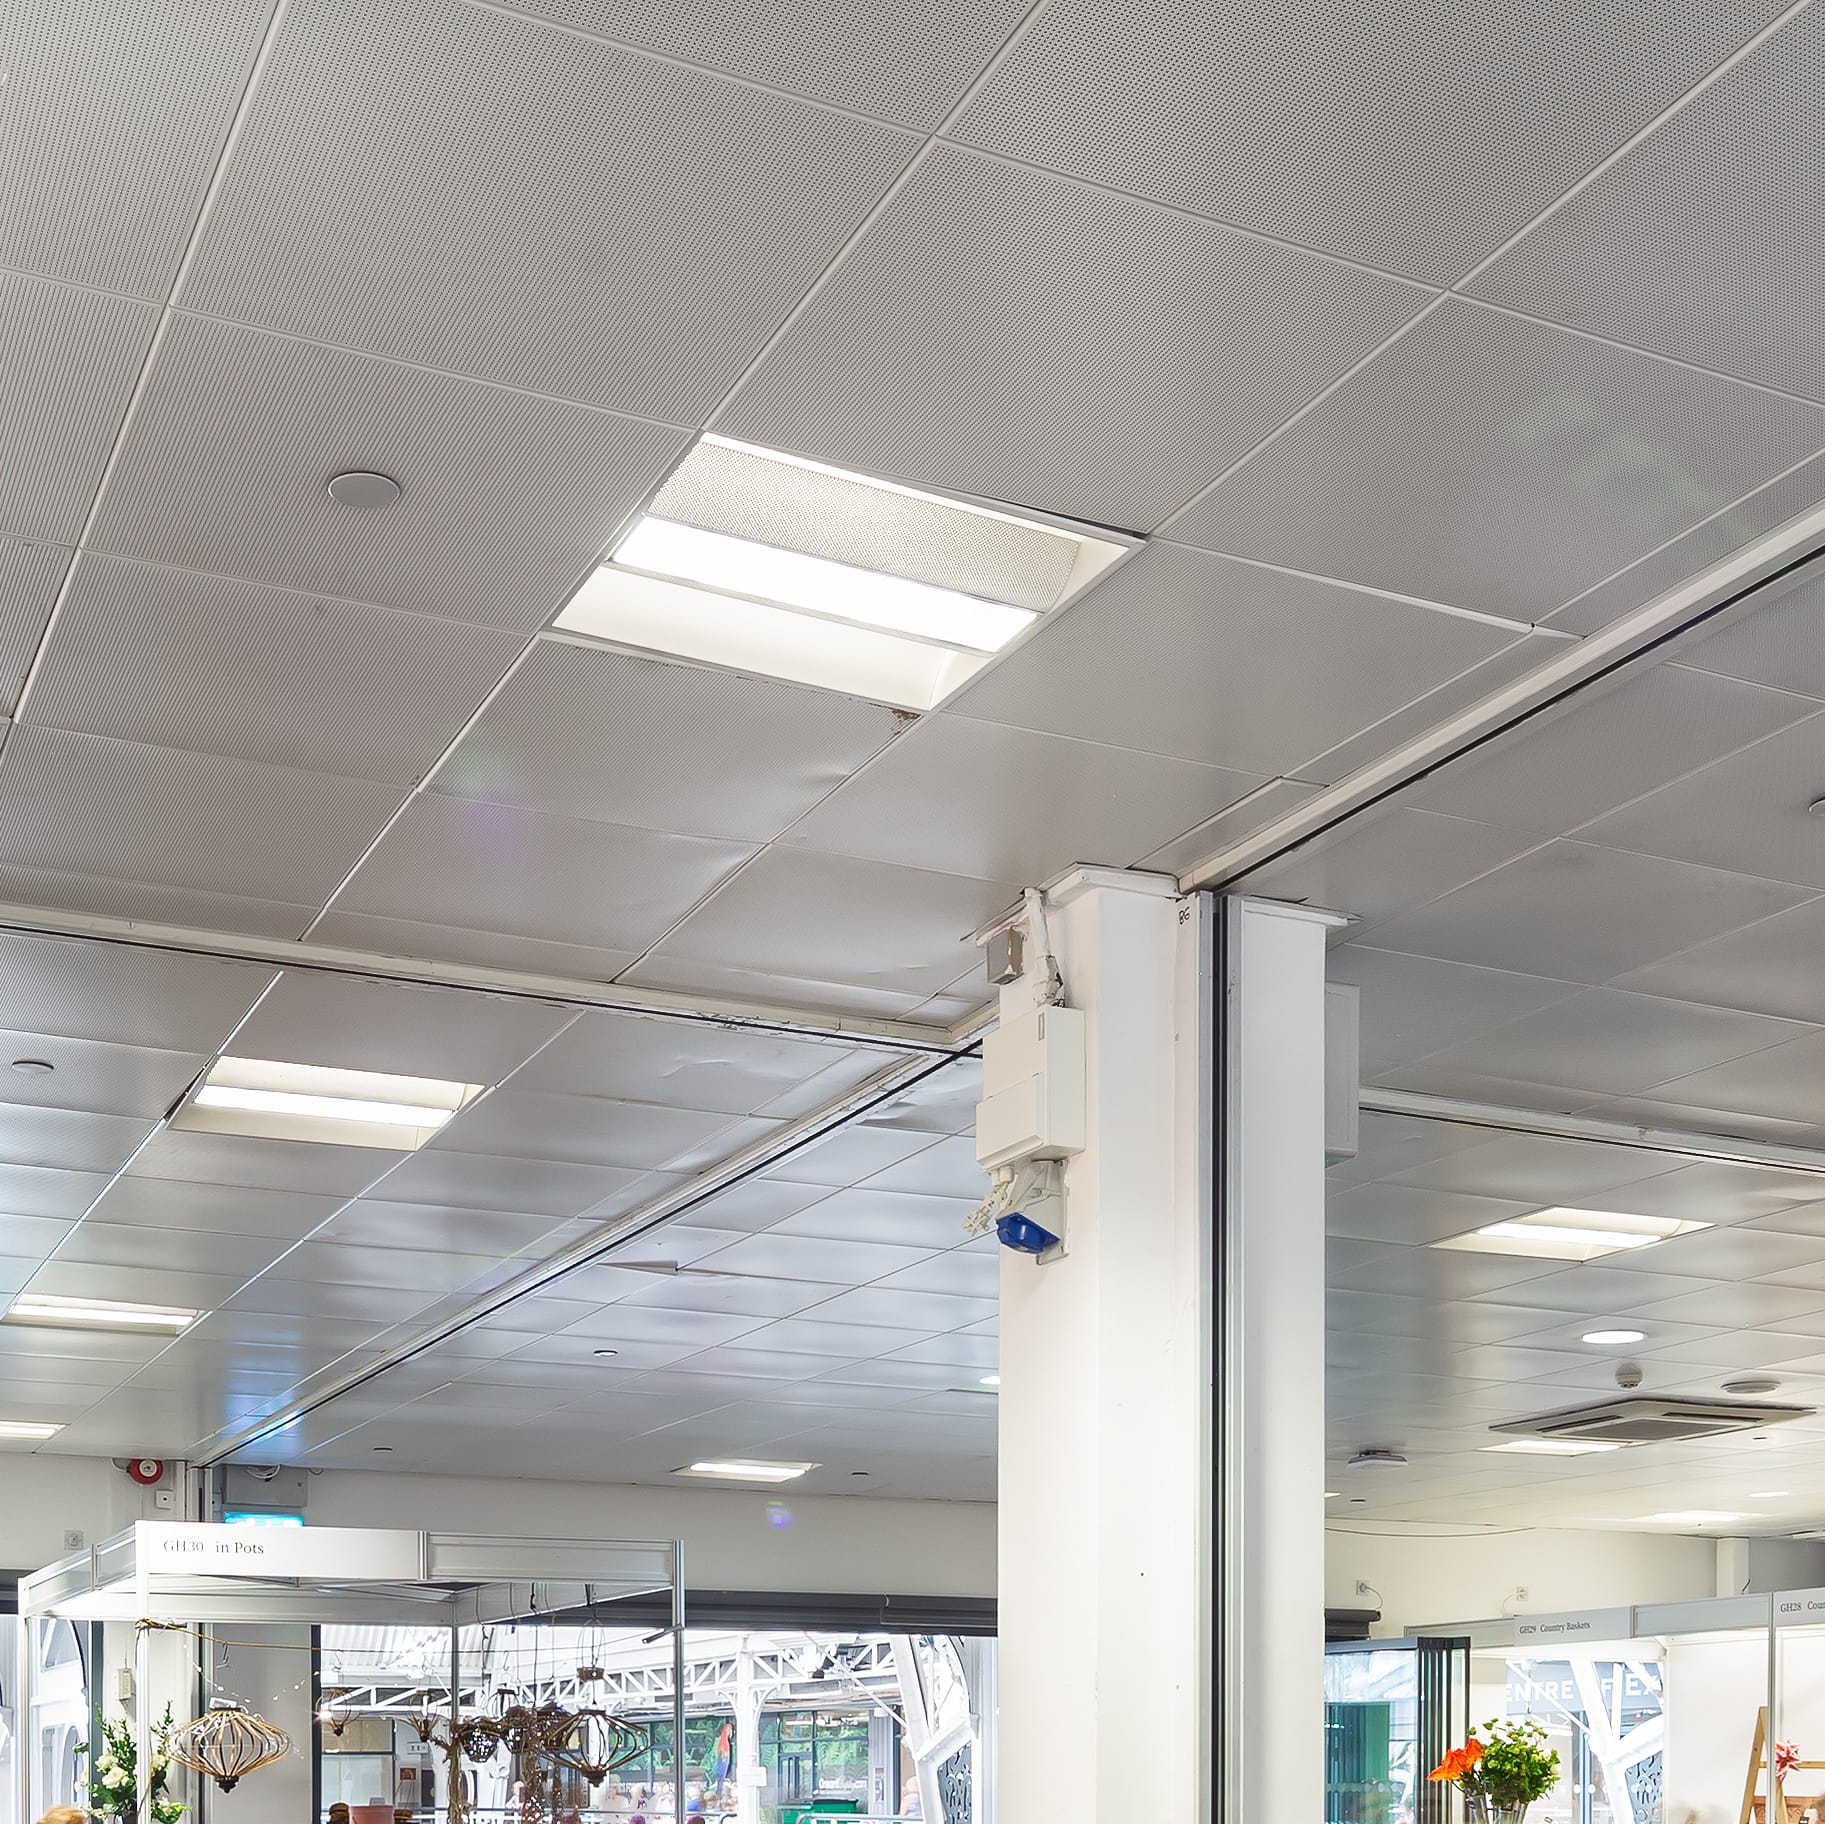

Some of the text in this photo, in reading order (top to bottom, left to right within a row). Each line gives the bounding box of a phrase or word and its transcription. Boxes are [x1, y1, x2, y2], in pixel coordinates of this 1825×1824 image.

[163, 1539, 264, 1555] GH30 in Pots
